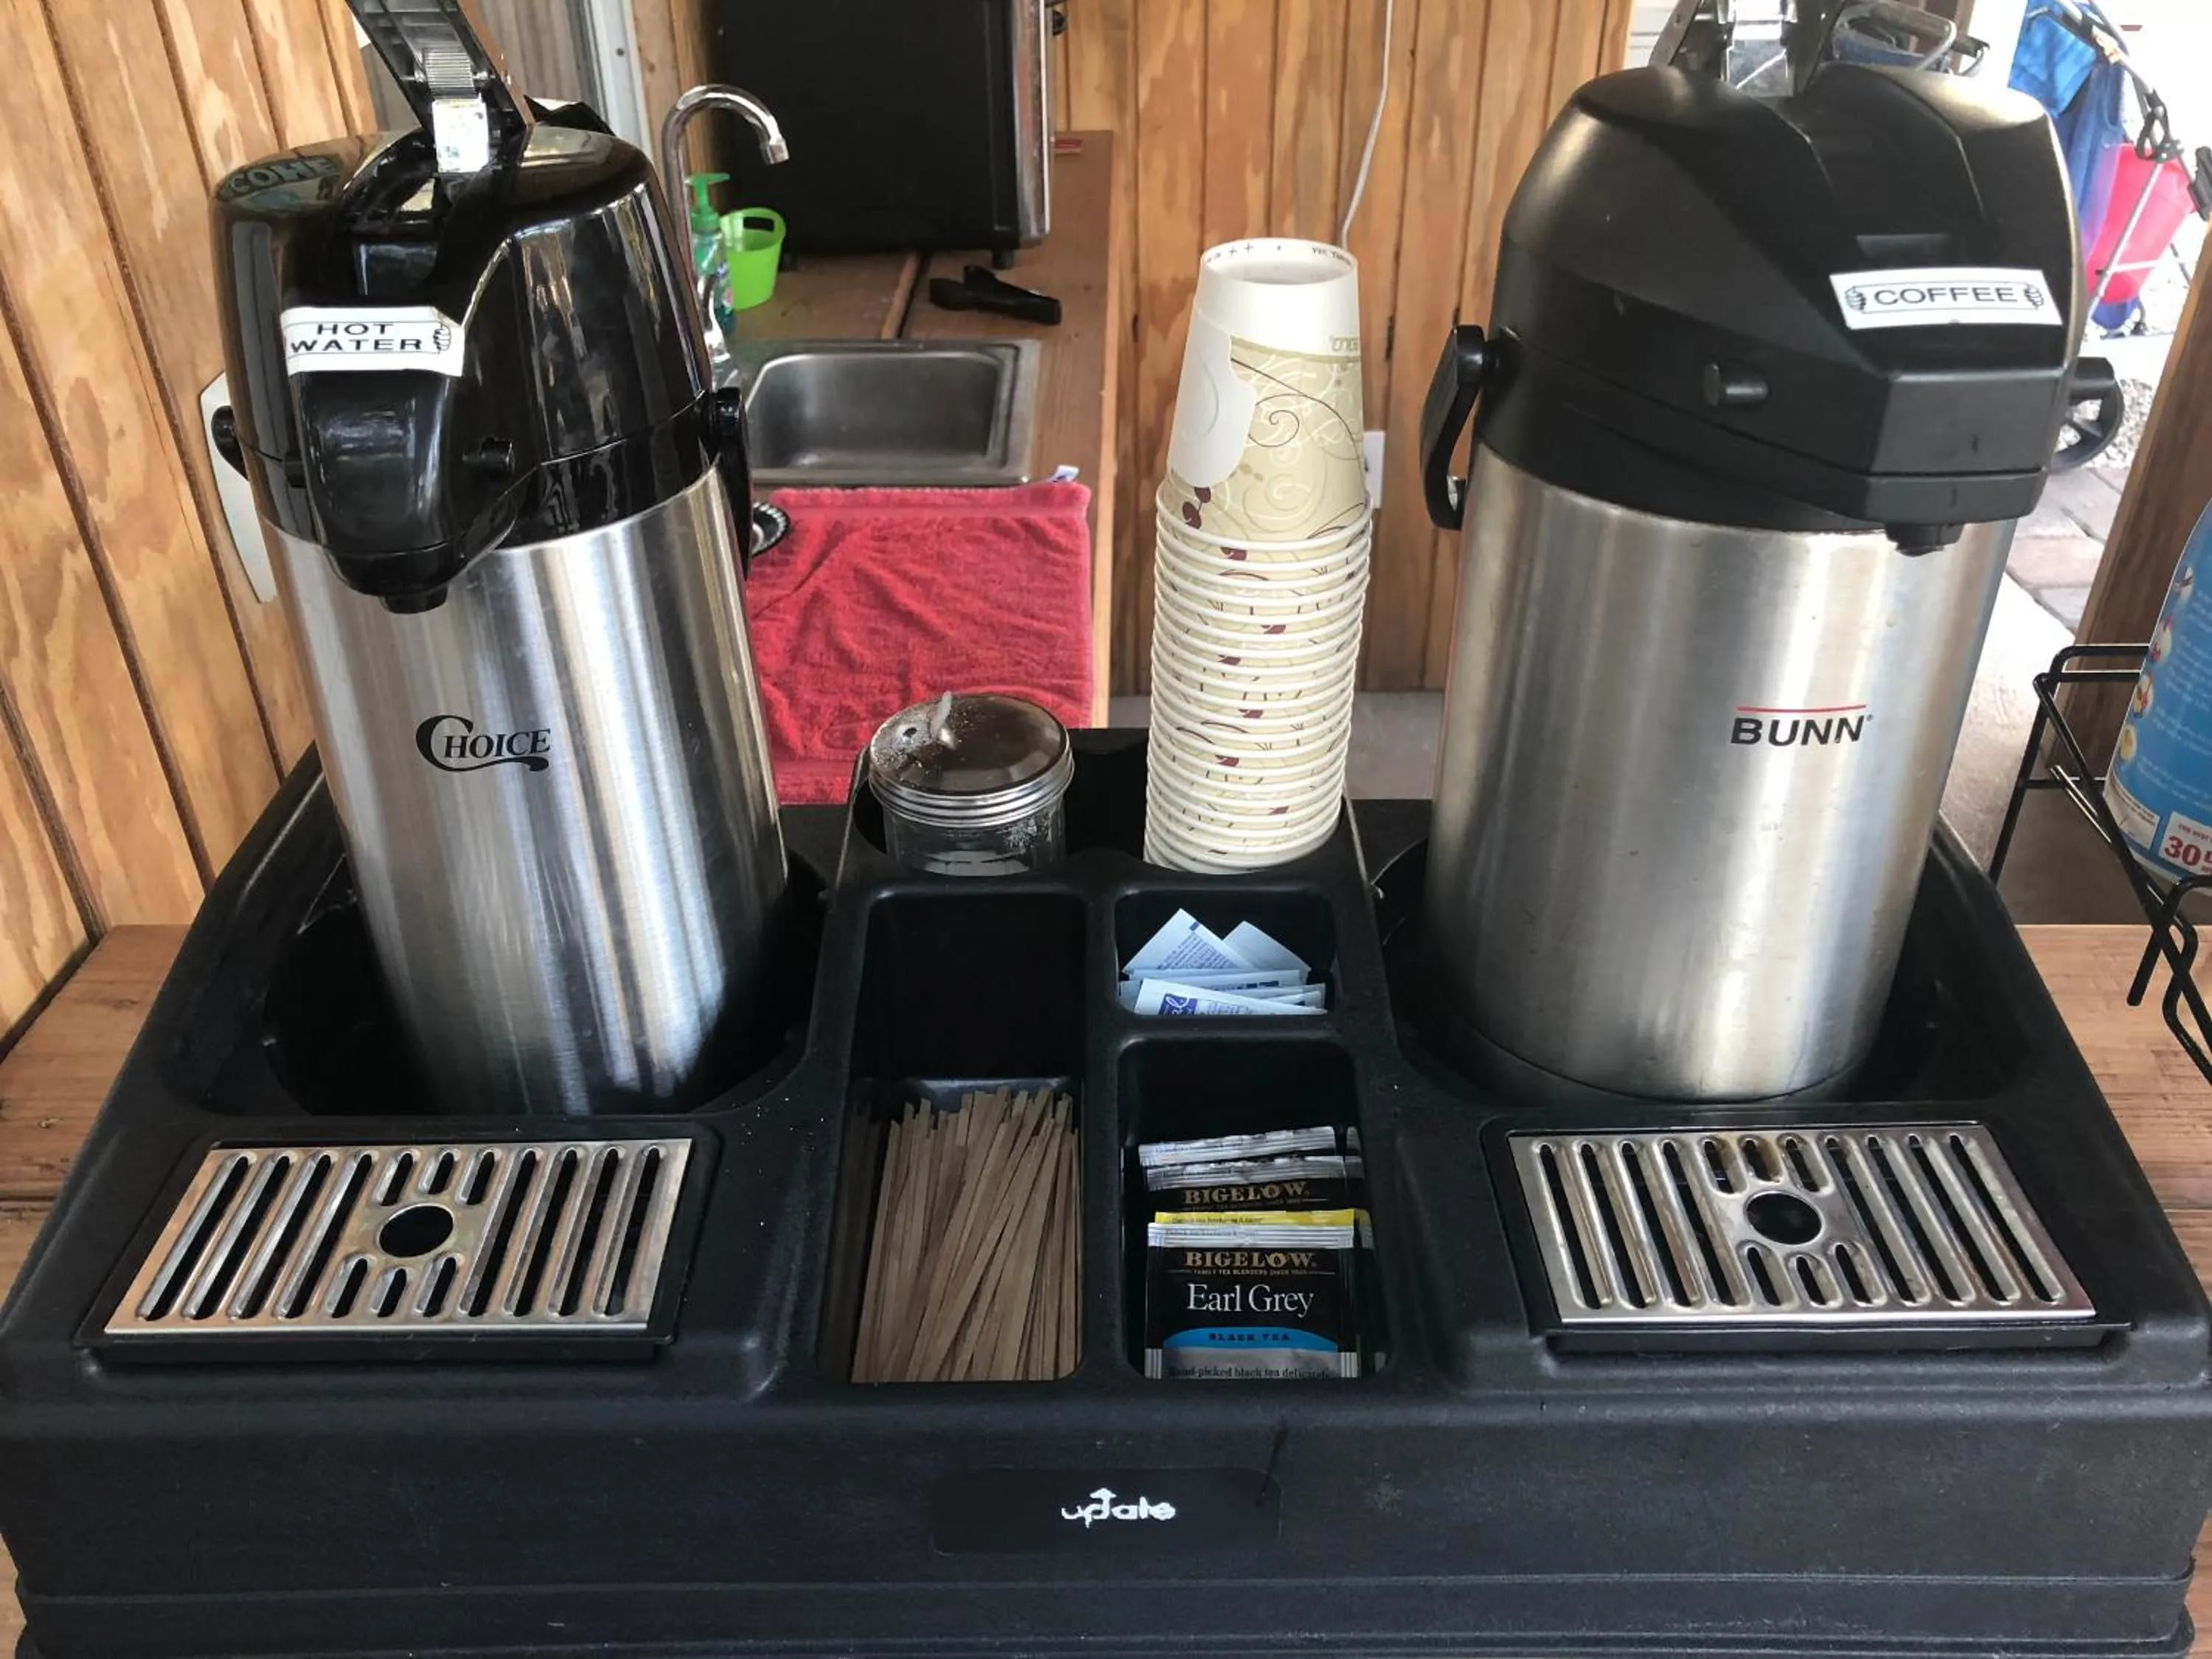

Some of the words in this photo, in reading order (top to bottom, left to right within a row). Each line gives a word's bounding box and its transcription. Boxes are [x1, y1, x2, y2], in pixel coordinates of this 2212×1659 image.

[1874, 287, 2018, 305] COFFEE
[316, 323, 394, 335] HOT
[291, 338, 422, 352] WATER
[1731, 714, 1865, 747] BUNN
[415, 714, 552, 772] CHOICE
[1185, 1182, 1308, 1204] BIGELOW
[1185, 1252, 1315, 1268] BIGELOW
[1186, 1283, 1242, 1312] Earl
[1248, 1284, 1315, 1318] Grey
[1208, 1332, 1254, 1341] BLACK
[1262, 1333, 1290, 1341] TEA
[1061, 1487, 1176, 1528] update
